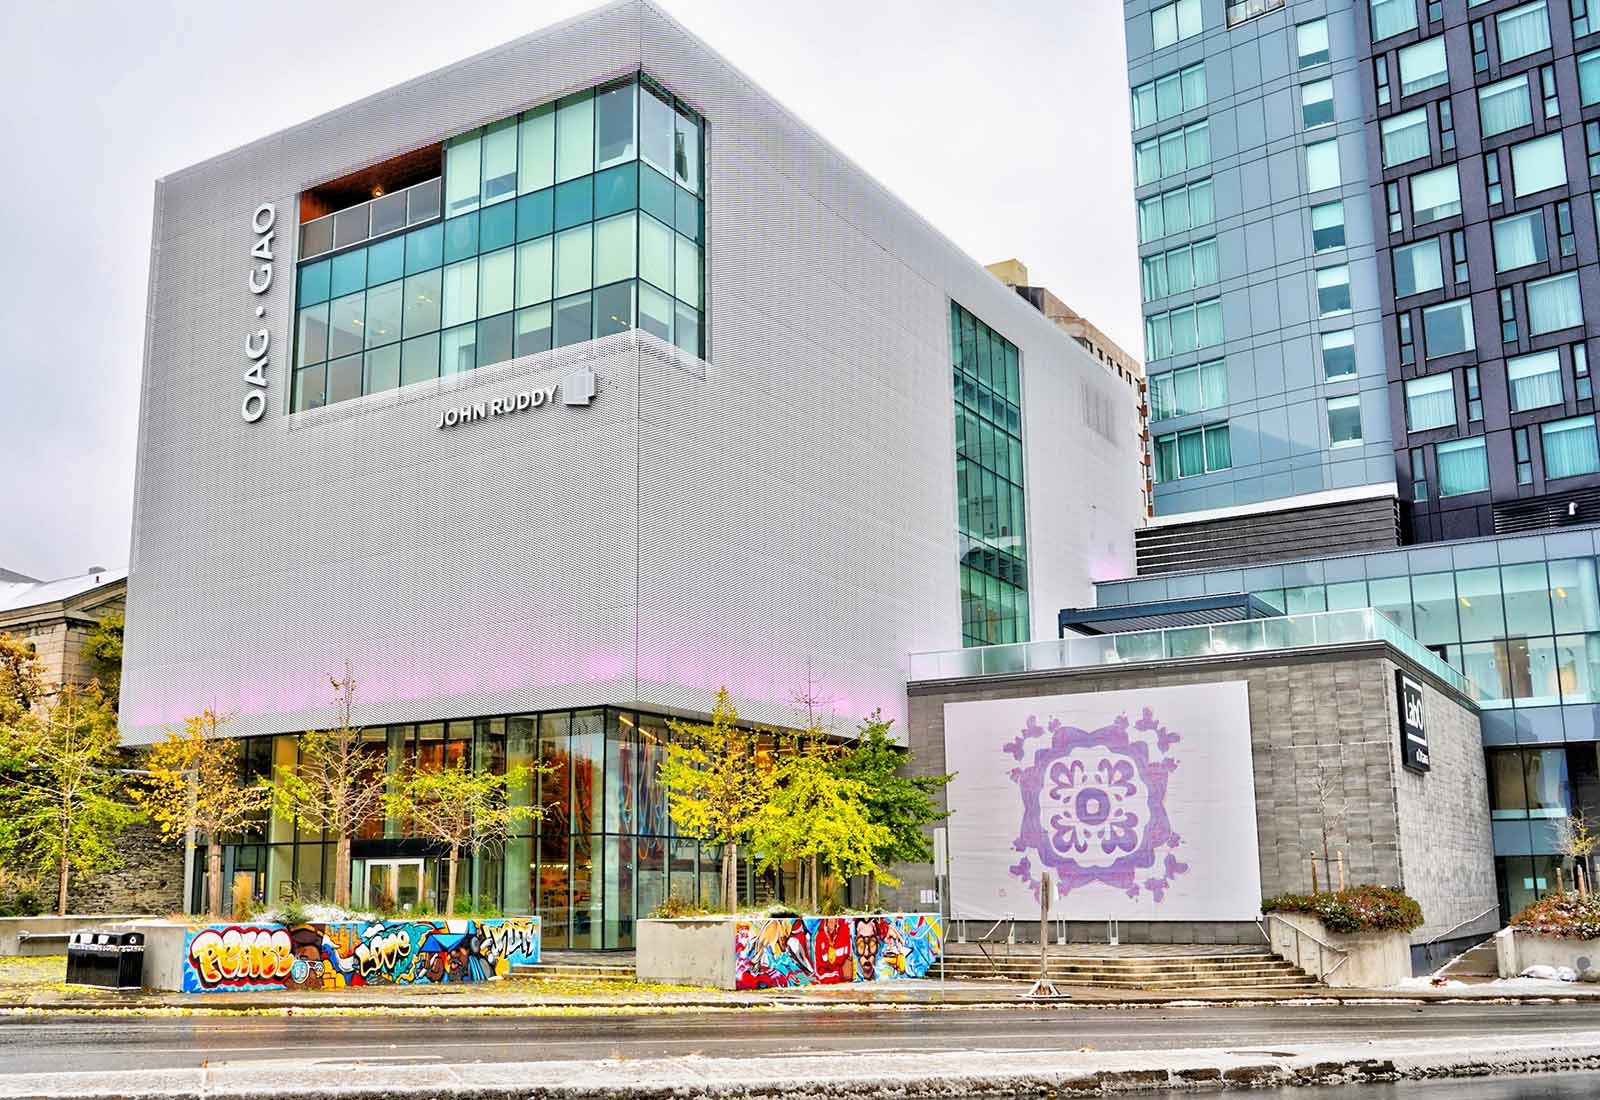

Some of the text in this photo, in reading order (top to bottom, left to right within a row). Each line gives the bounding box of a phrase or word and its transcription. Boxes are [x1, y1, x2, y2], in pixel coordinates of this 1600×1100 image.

[241, 202, 276, 423] OAG GAO
[436, 384, 559, 429] JOHN RUDDY
